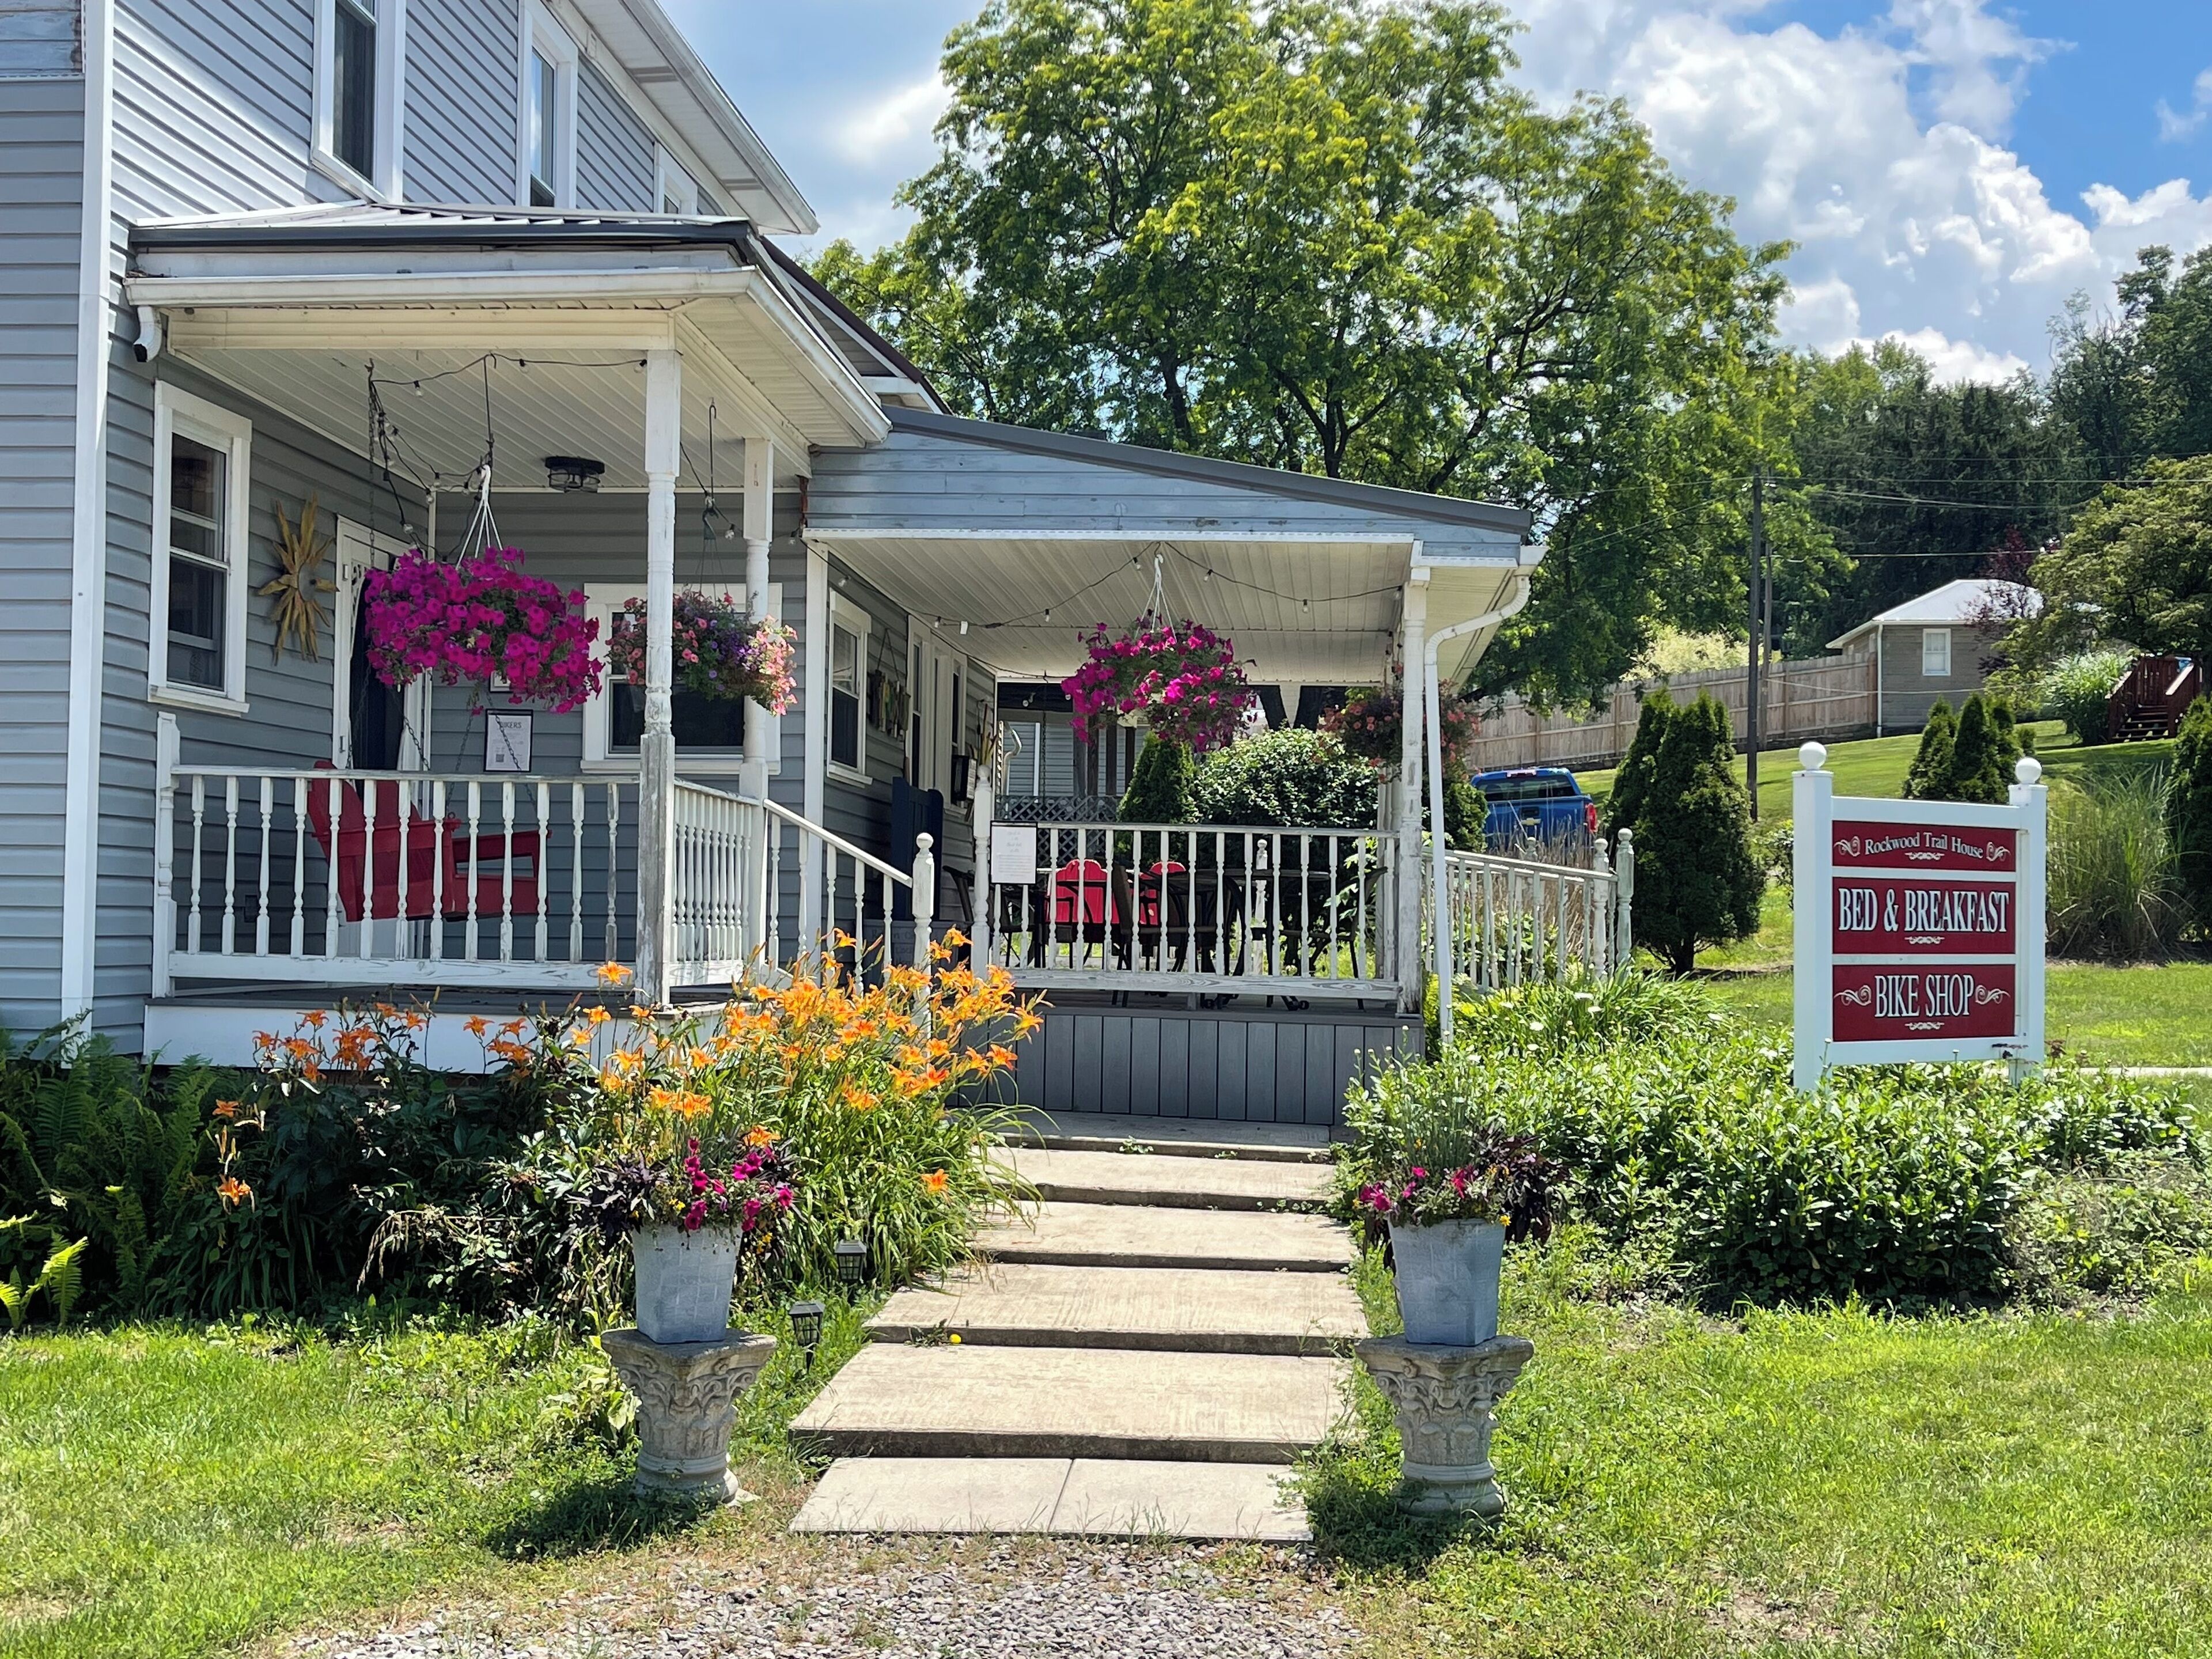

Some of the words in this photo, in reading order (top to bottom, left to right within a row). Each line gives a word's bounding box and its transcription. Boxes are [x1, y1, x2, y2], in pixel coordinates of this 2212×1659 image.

[1865, 832, 1920, 855] Rockwood
[1923, 832, 1948, 850] Trail
[1952, 837, 1983, 858] House
[1839, 888, 1878, 931] BED
[1884, 889, 1899, 932] &
[1904, 890, 2009, 932] BREAKFAST
[1874, 975, 1920, 1017] BIKE
[1925, 974, 1975, 1017] SHOP
